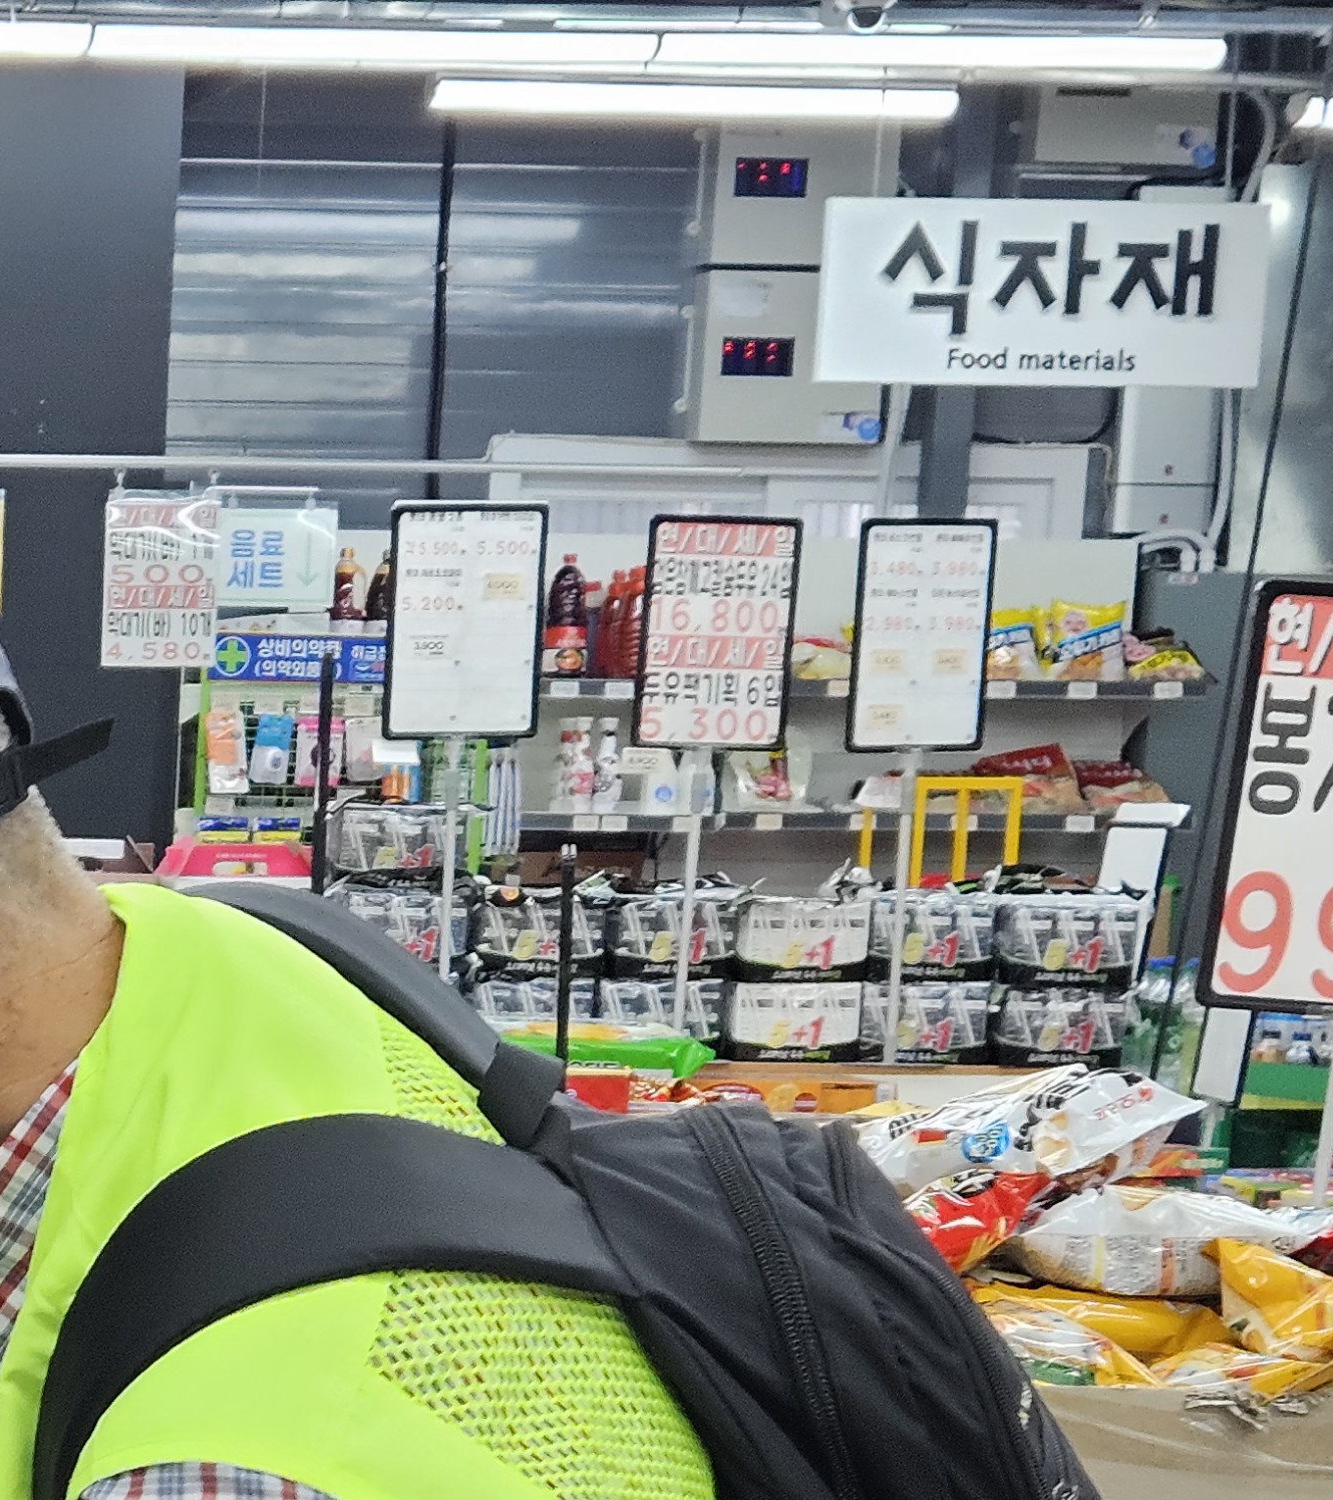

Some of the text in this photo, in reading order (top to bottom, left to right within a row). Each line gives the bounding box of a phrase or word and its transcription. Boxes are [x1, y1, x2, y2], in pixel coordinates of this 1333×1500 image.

[879, 219, 1221, 336] 식자재
[947, 347, 1135, 372] Food materials
[230, 529, 286, 558] 음료
[226, 561, 284, 589] 세트
